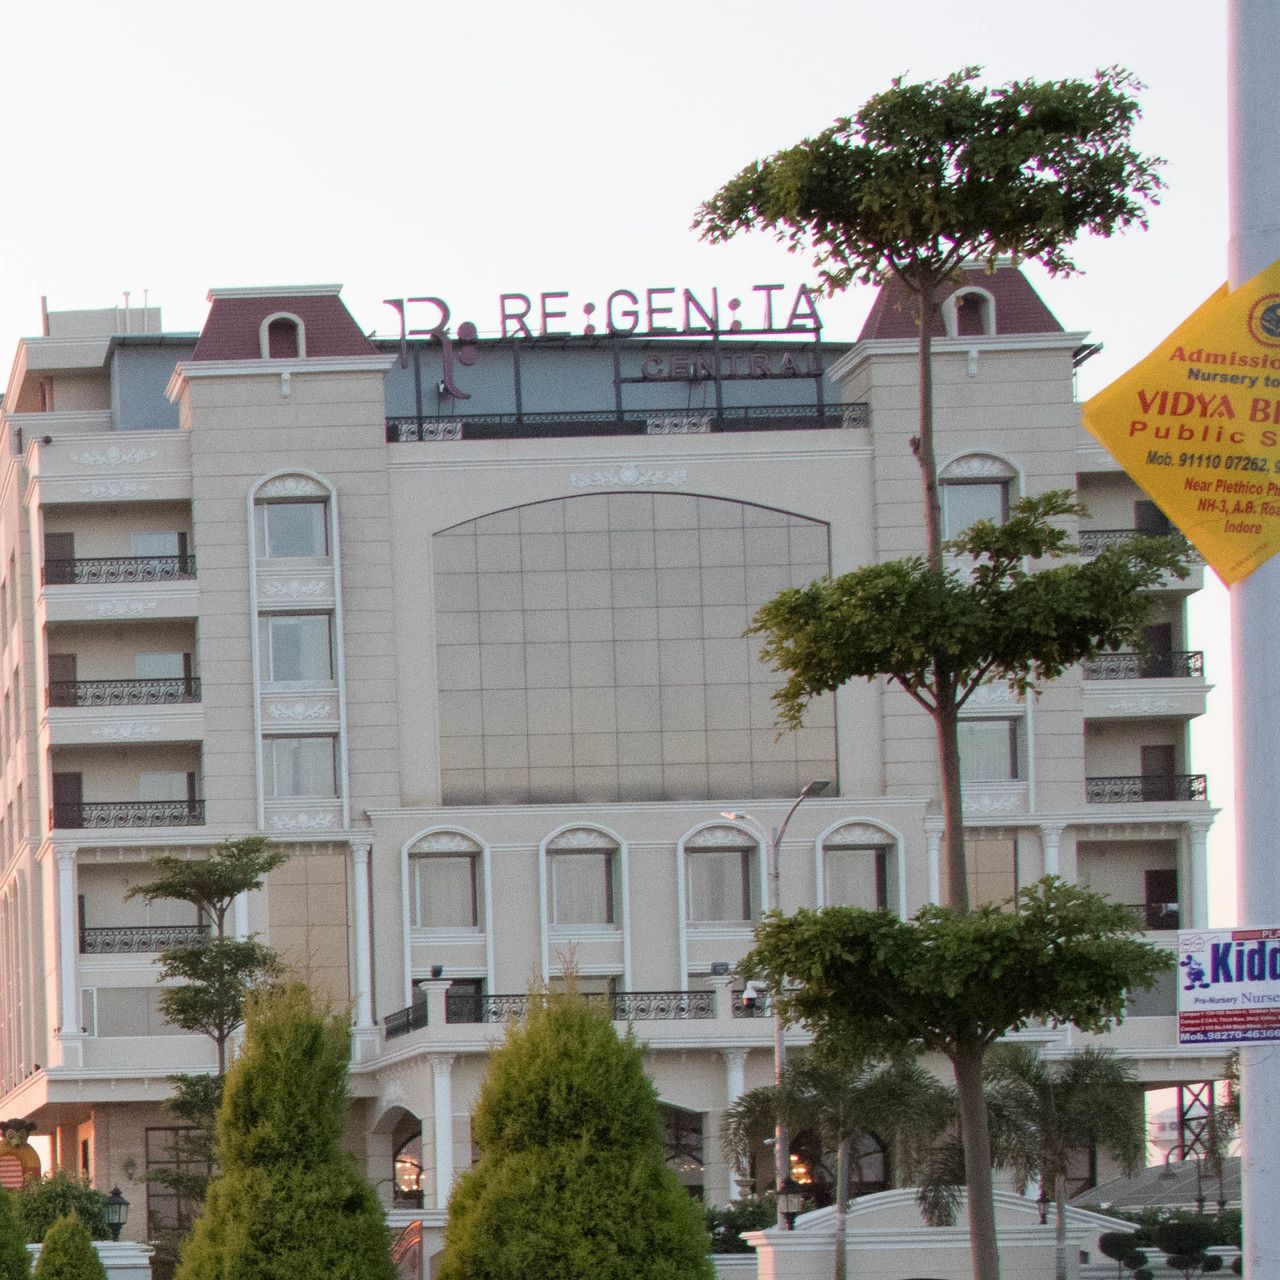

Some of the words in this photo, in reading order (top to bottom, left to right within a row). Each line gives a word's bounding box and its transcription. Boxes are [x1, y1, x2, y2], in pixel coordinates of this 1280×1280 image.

[641, 351, 823, 379] CENTRAL
[1187, 367, 1259, 389] Nursery
[1264, 375, 1280, 388] to
[1138, 388, 1236, 420] VIDYA
[1129, 421, 1245, 444] Public
[1146, 450, 1173, 466] Mob.
[1179, 452, 1221, 469] 91110
[1184, 477, 1212, 492] Near
[1215, 479, 1264, 495] Plethico
[1198, 498, 1229, 517] NH-3,
[1224, 520, 1263, 534] Indore
[1194, 997, 1237, 1006] Pre-Nursery
